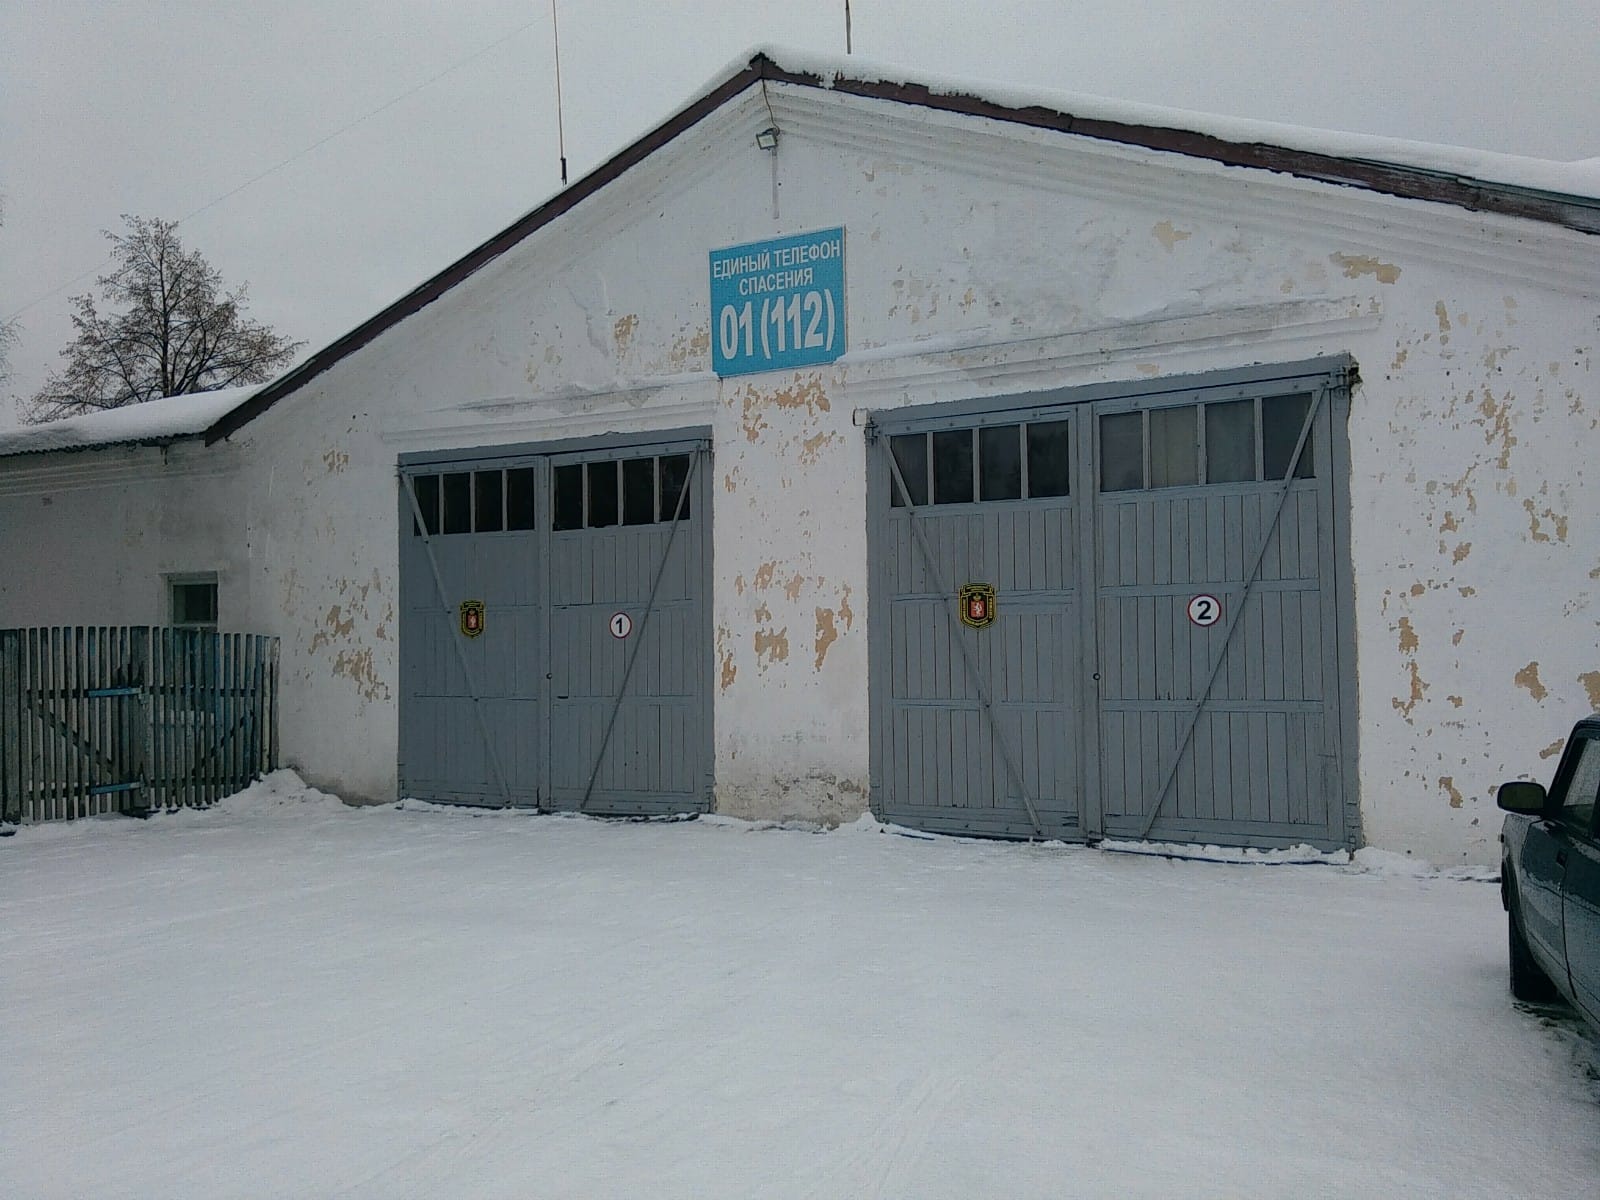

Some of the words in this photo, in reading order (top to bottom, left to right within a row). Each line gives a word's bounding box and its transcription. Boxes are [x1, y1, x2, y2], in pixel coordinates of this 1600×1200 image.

[713, 250, 770, 280] ЕДИНЫЙ
[774, 239, 841, 268] ТЕЛЕФОН
[739, 267, 813, 296] СПАСЕНИЯ
[720, 301, 753, 360] 01
[761, 288, 836, 360] (112)
[1197, 600, 1211, 620] 2
[615, 618, 623, 634] 1
